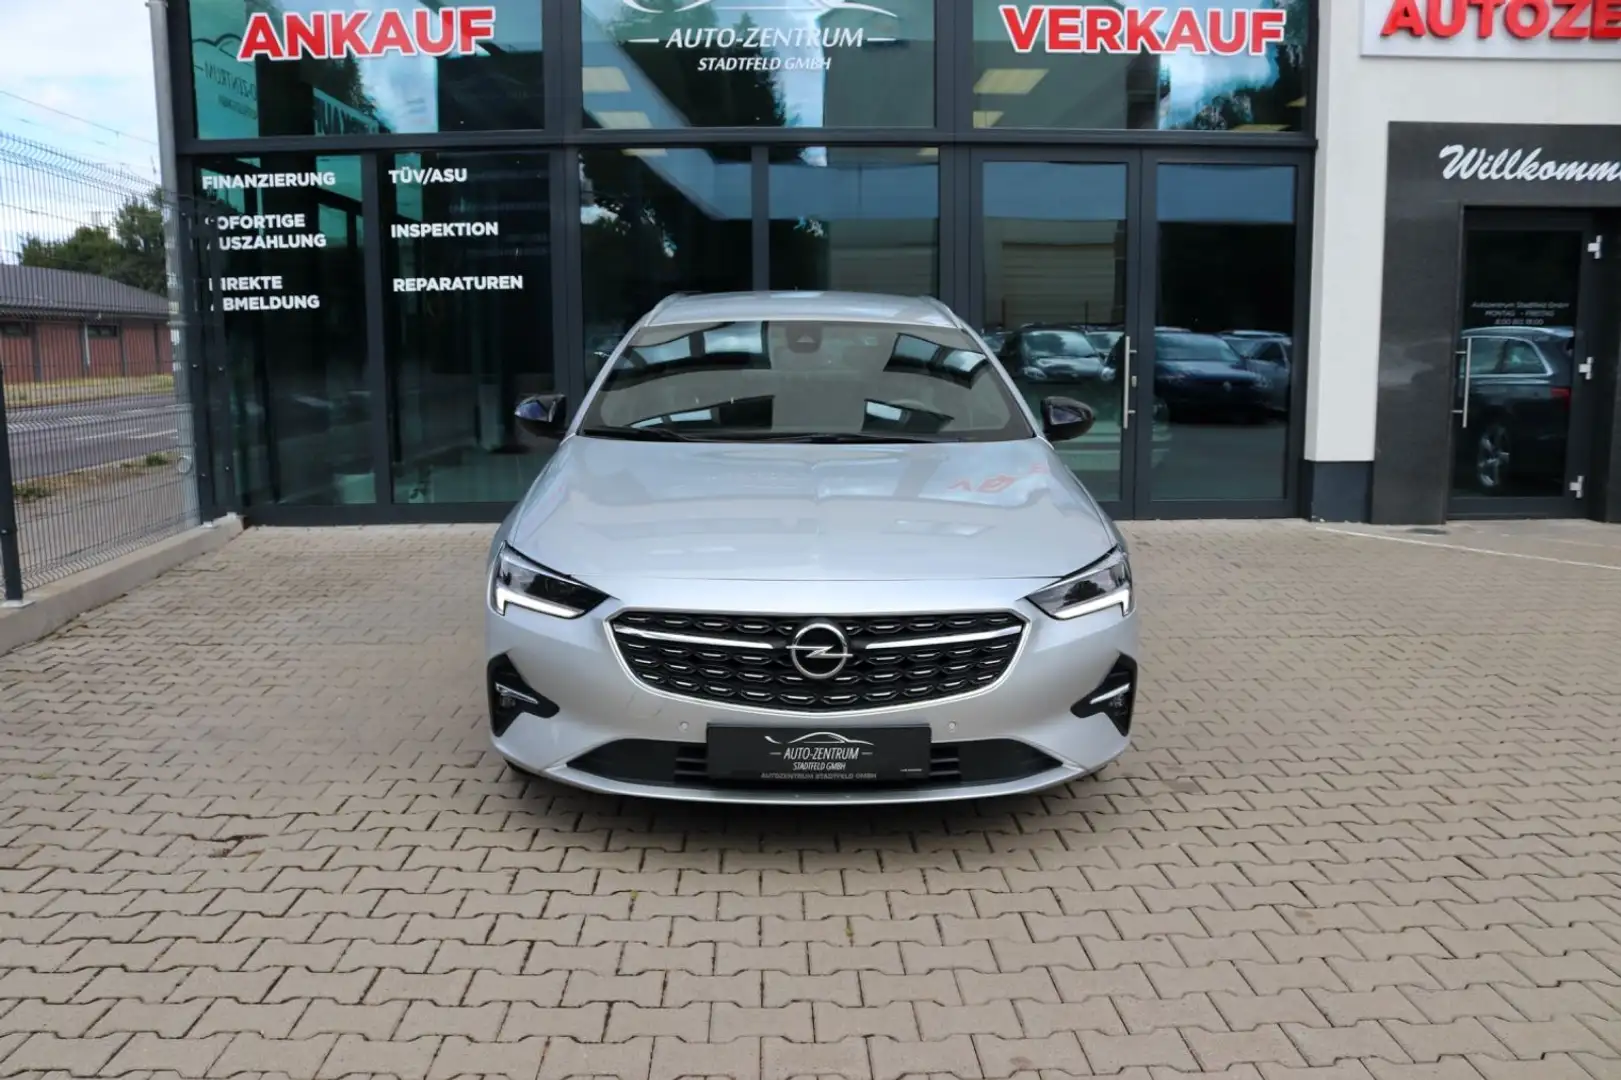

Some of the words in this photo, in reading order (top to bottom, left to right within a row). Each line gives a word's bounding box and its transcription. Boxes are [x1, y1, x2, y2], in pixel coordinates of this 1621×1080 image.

[1380, 0, 1621, 40] AUTOZE
[236, 6, 496, 62] ANKAUF
[665, 27, 863, 49] AUTO-ZENTRUM
[999, 5, 1287, 56] VERKAUF
[698, 57, 781, 71] STADTFELD
[784, 57, 832, 71] GMBH
[1438, 144, 1621, 182] Willkomm
[202, 171, 336, 190] FINANZIERUNG
[388, 166, 468, 185] TÜV/ASU
[205, 213, 306, 230] OFORTIGE
[391, 221, 499, 239] INSPEKTION
[207, 233, 327, 251] USZAHLUNG
[209, 275, 283, 292] IREKTE
[393, 275, 524, 292] REPARATUREN
[210, 294, 321, 312] BMELDUNG
[783, 747, 859, 760] AUTO-ZENTRUM
[793, 761, 825, 771] STADTFELD
